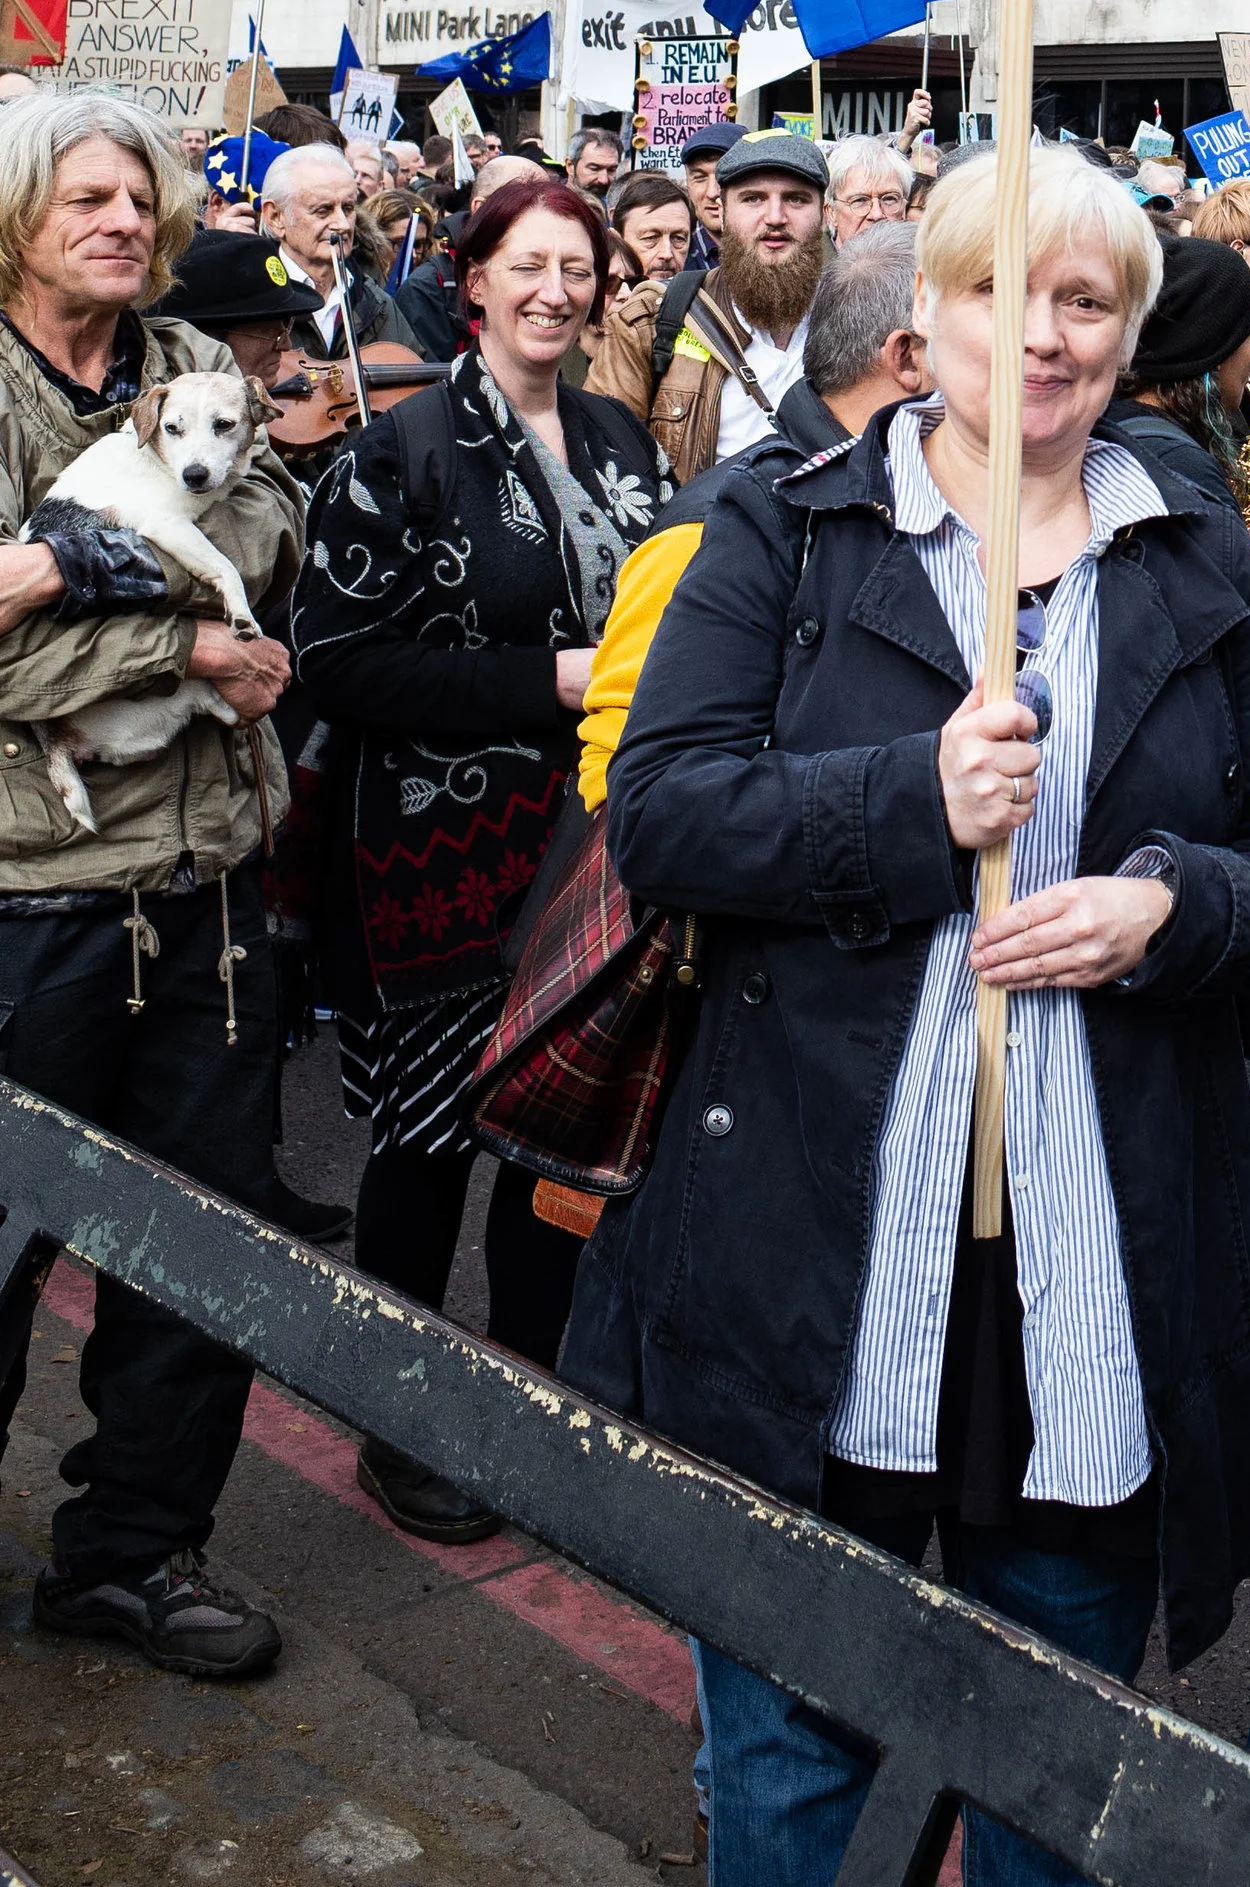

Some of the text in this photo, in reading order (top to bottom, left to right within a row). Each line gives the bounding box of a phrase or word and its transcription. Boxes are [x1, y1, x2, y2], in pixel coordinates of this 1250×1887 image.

[385, 11, 431, 42] MINI
[436, 6, 481, 41] Park
[582, 10, 627, 51] exit
[77, 22, 208, 57] ANSWER,
[665, 42, 729, 65] REMAIN
[84, 57, 147, 83] STUPID
[150, 59, 221, 83] FUCKING
[661, 65, 720, 84] IN E.U.
[661, 85, 727, 105] relocate
[658, 106, 713, 126] Parliament
[823, 91, 905, 134] MINI
[640, 158, 669, 169] want
[641, 146, 666, 159] then
[1217, 148, 1250, 178] OUT
